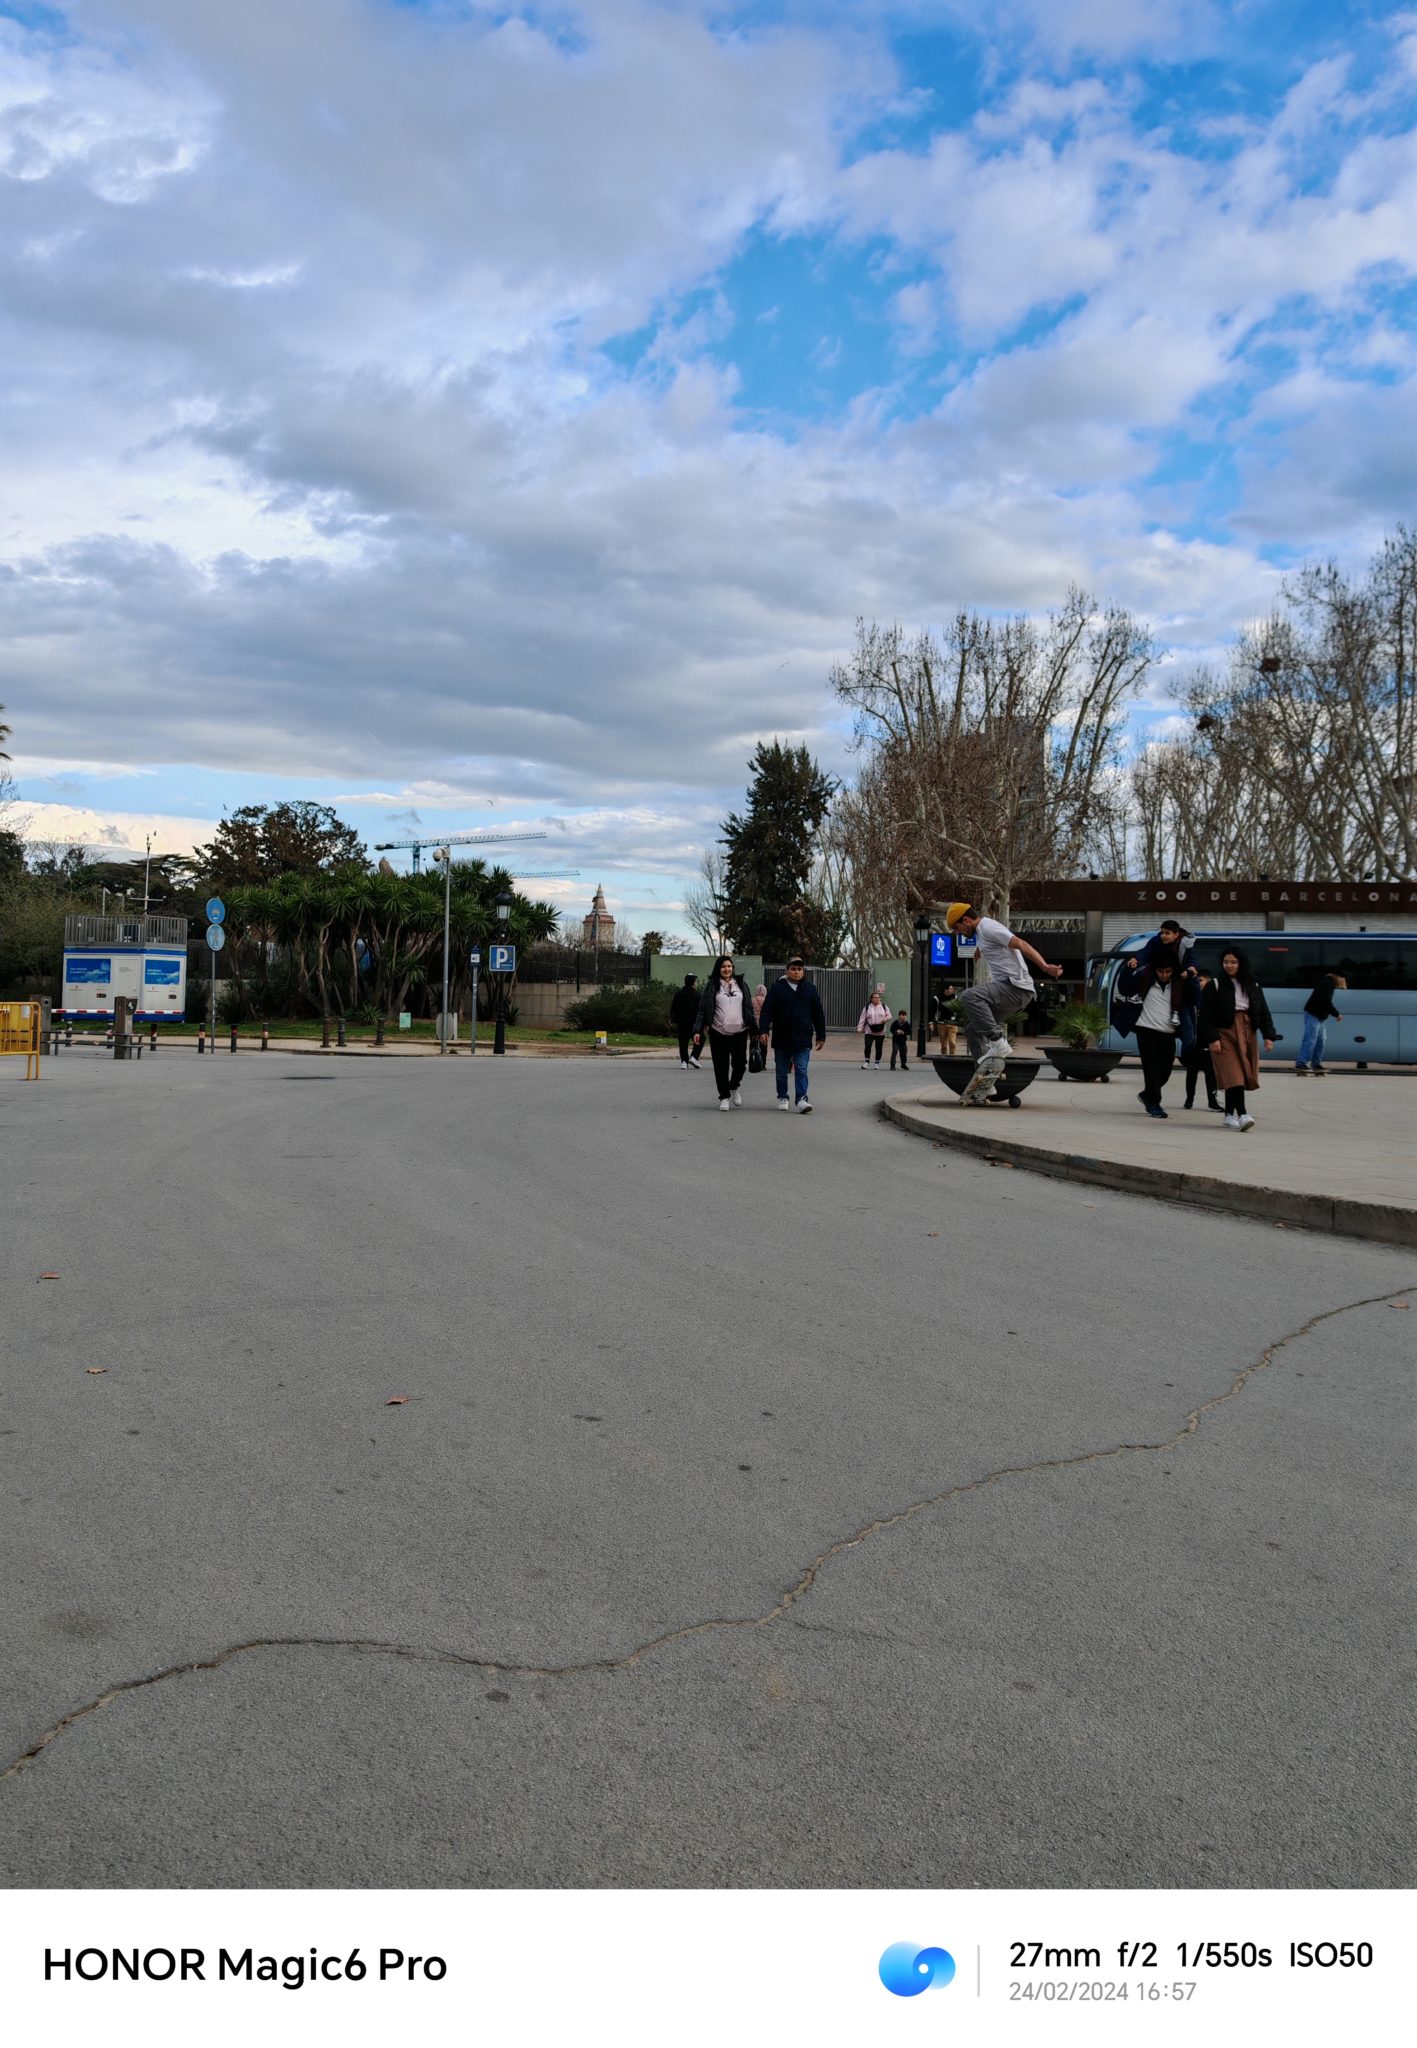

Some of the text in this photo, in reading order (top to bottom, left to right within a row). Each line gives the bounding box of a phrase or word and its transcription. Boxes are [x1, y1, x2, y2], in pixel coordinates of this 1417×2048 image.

[1137, 891, 1417, 901] ZOO DE BARCELONA
[496, 947, 508, 969] P
